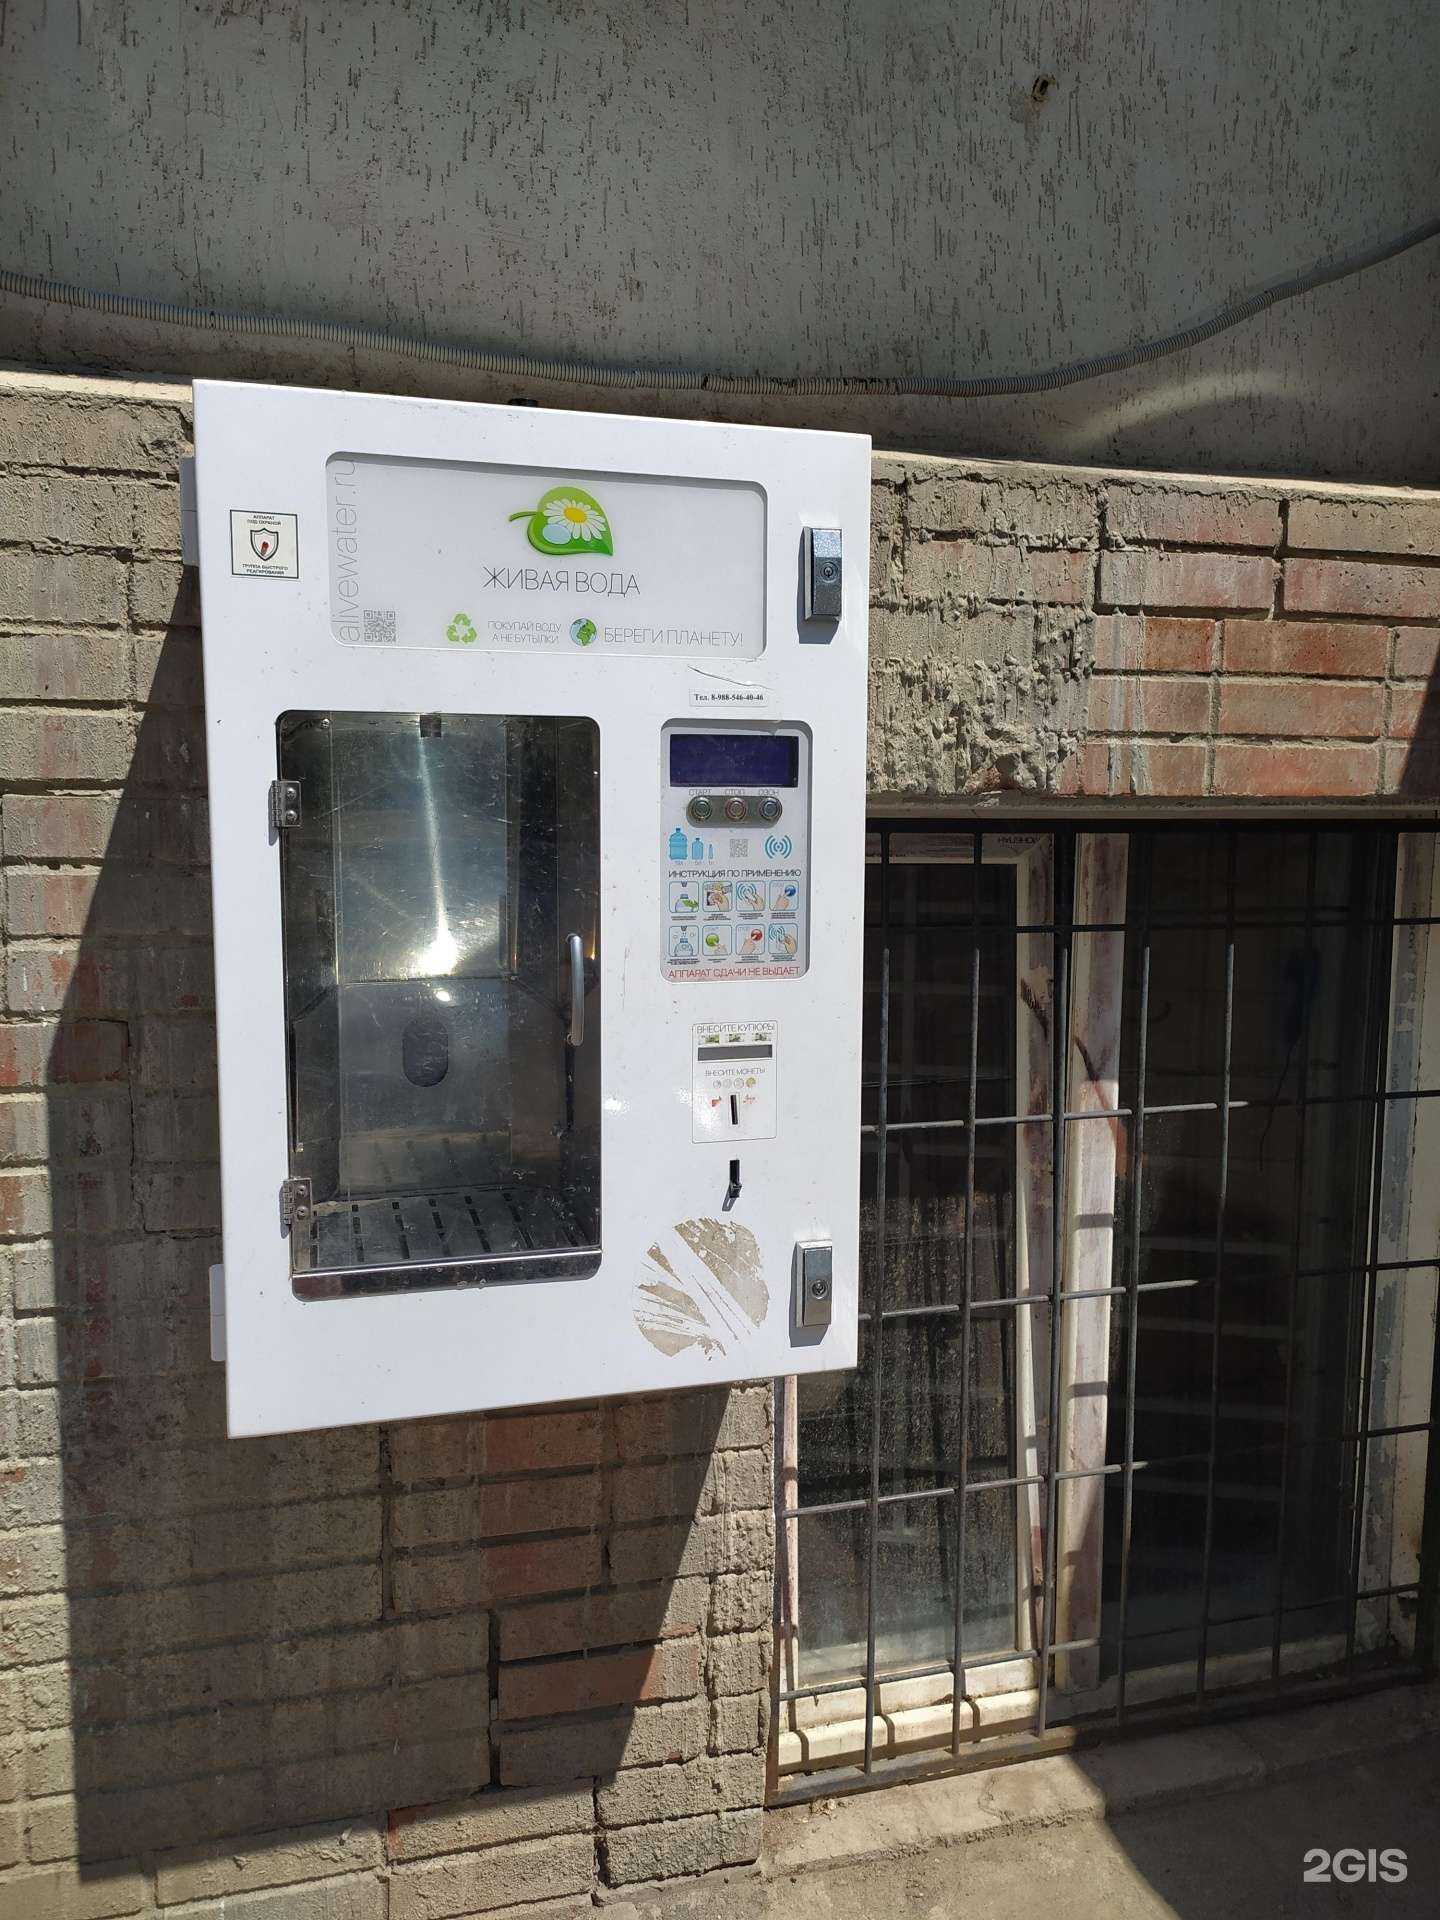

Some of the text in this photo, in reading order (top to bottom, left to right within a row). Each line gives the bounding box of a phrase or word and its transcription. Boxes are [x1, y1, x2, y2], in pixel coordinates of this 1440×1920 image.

[331, 460, 360, 642] alivewater.ru
[482, 566, 640, 598] ЖИВАЯ ВОДА
[488, 620, 534, 633] ПОКУПАЙ
[493, 633, 560, 644] А НЕ БУТЫЛКИ
[605, 627, 743, 647] БЕРЕГИ ПЛАНЕТУ!
[694, 692, 764, 702] Тел. 8-988-546-40-46
[668, 868, 802, 878] ИНСТРУКЦИЯ ПО ПРИМЕНЕНИЮ
[669, 966, 800, 979] АППАРАТ СДАЧИ НЕ ВЫДАЕТ
[697, 1022, 775, 1034] ВНЕСИТЕ КУПЮРЫ
[704, 1069, 735, 1077] ВНЕСИТЕ
